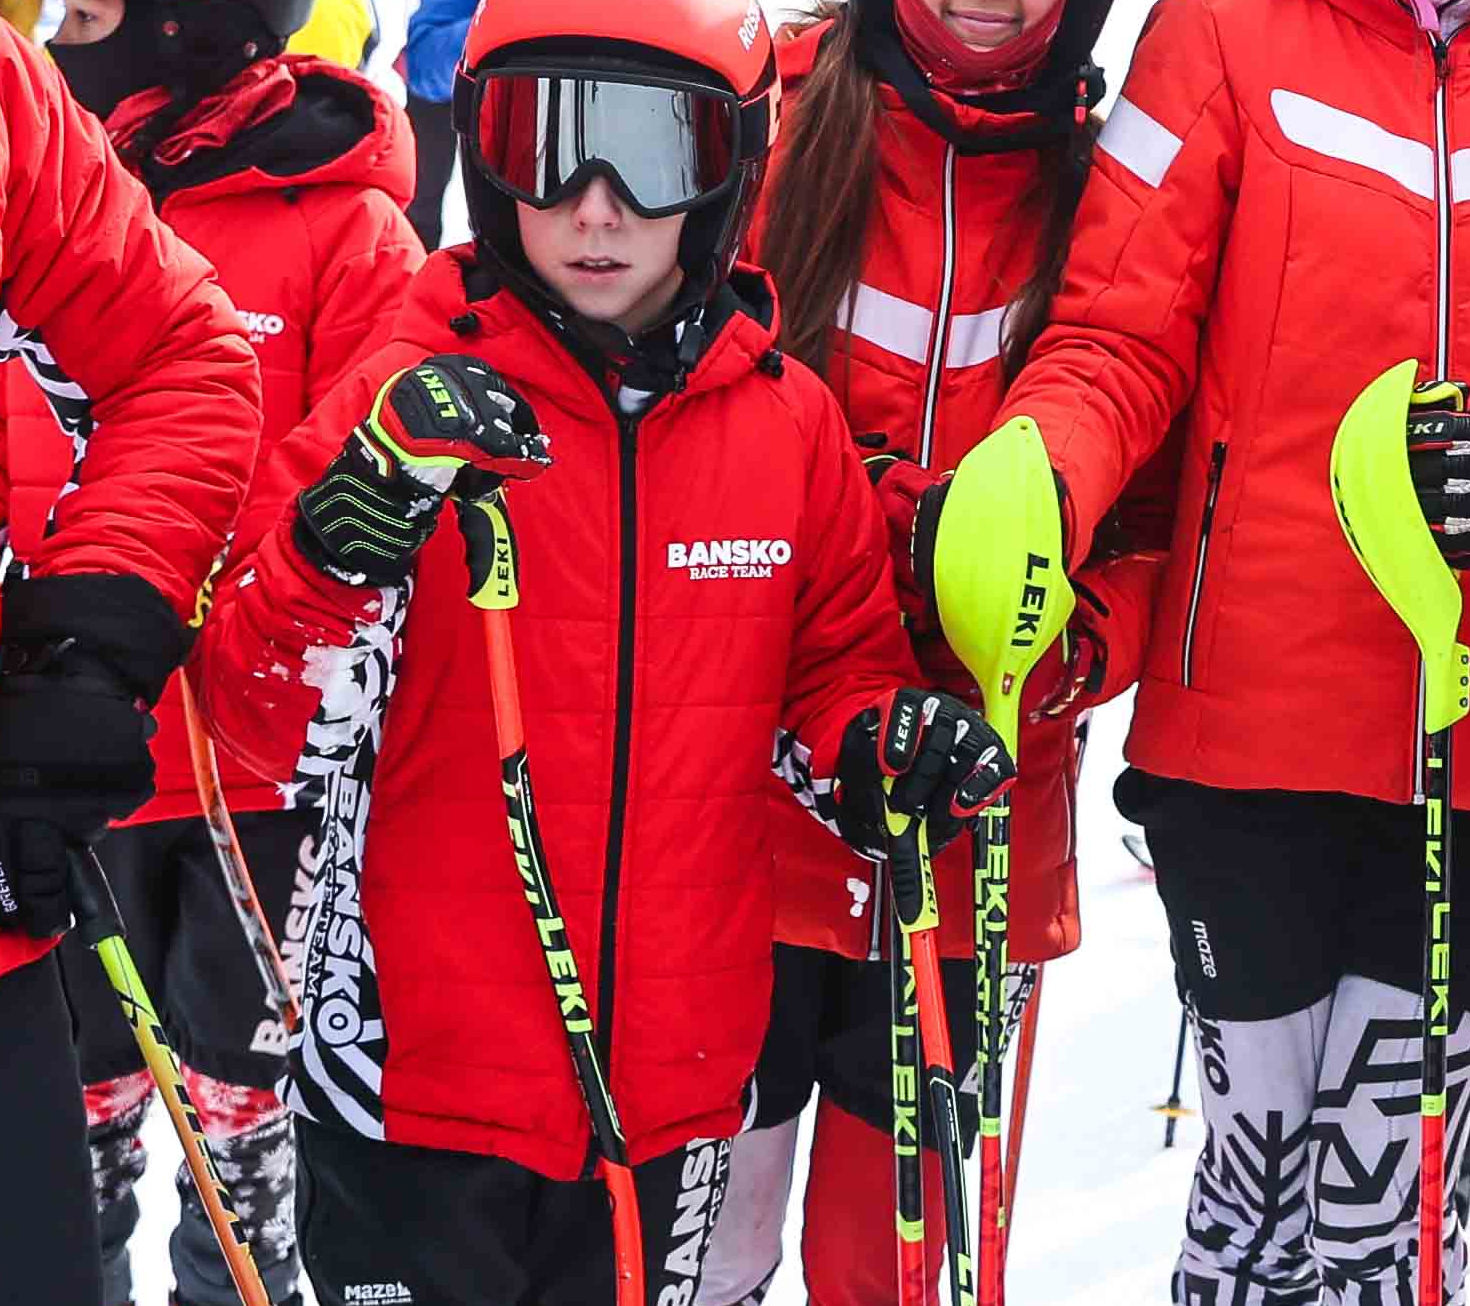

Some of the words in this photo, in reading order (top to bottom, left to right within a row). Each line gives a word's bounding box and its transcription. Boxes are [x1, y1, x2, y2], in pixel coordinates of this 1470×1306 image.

[415, 366, 459, 420] LEKI
[492, 535, 507, 598] LEKI
[667, 539, 792, 569] BANSKO
[690, 566, 729, 581] RACE
[731, 566, 773, 580] TEAM
[1012, 553, 1049, 648] LEKI
[895, 706, 914, 752] LEKI
[321, 777, 365, 1049] BANSKO
[536, 915, 595, 1035] LEKI
[1191, 919, 1218, 979] maze
[1426, 900, 1452, 1037] LEKI
[891, 1025, 918, 1156] LEKI
[344, 1282, 397, 1300] Maze
